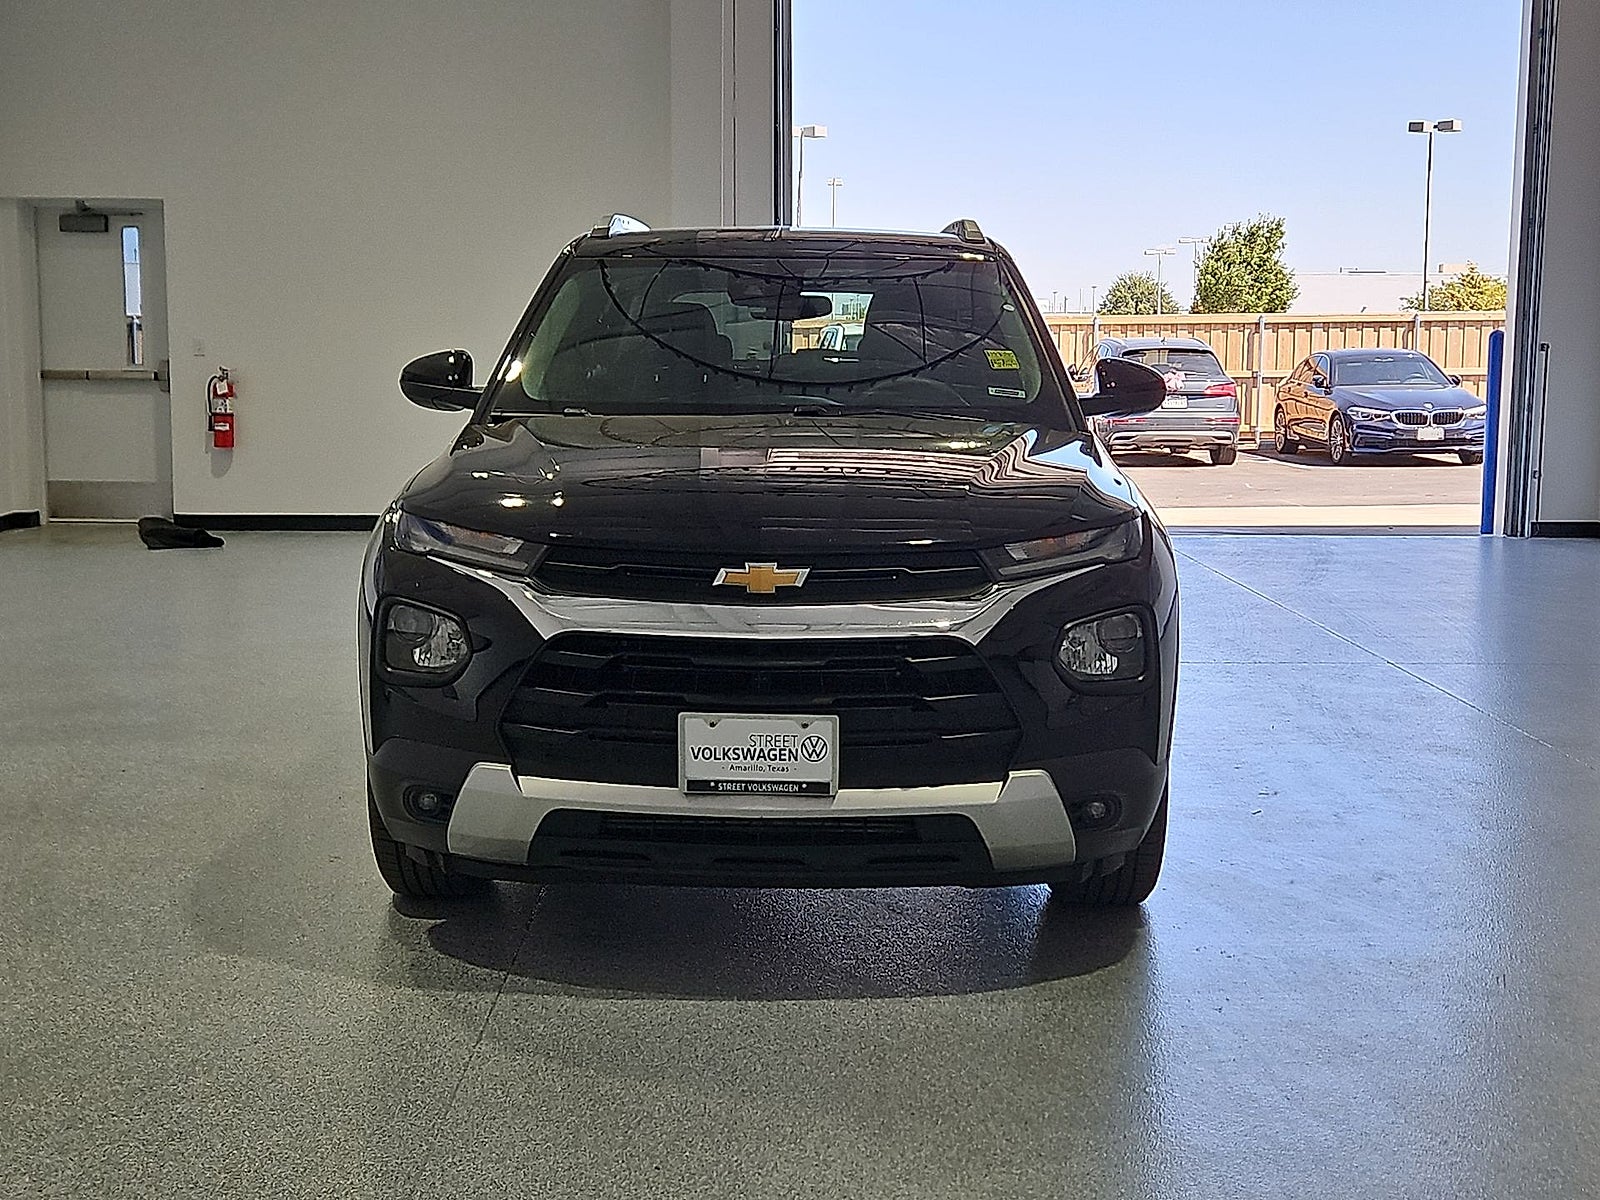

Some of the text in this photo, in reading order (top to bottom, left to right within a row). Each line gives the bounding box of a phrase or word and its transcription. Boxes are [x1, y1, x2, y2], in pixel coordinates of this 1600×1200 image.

[749, 734, 798, 748] STREET
[690, 747, 799, 762] VOLKSWAGEN
[729, 764, 790, 773] Amarillo, Texas
[718, 783, 799, 792] STREET VOLKSWAGEN
